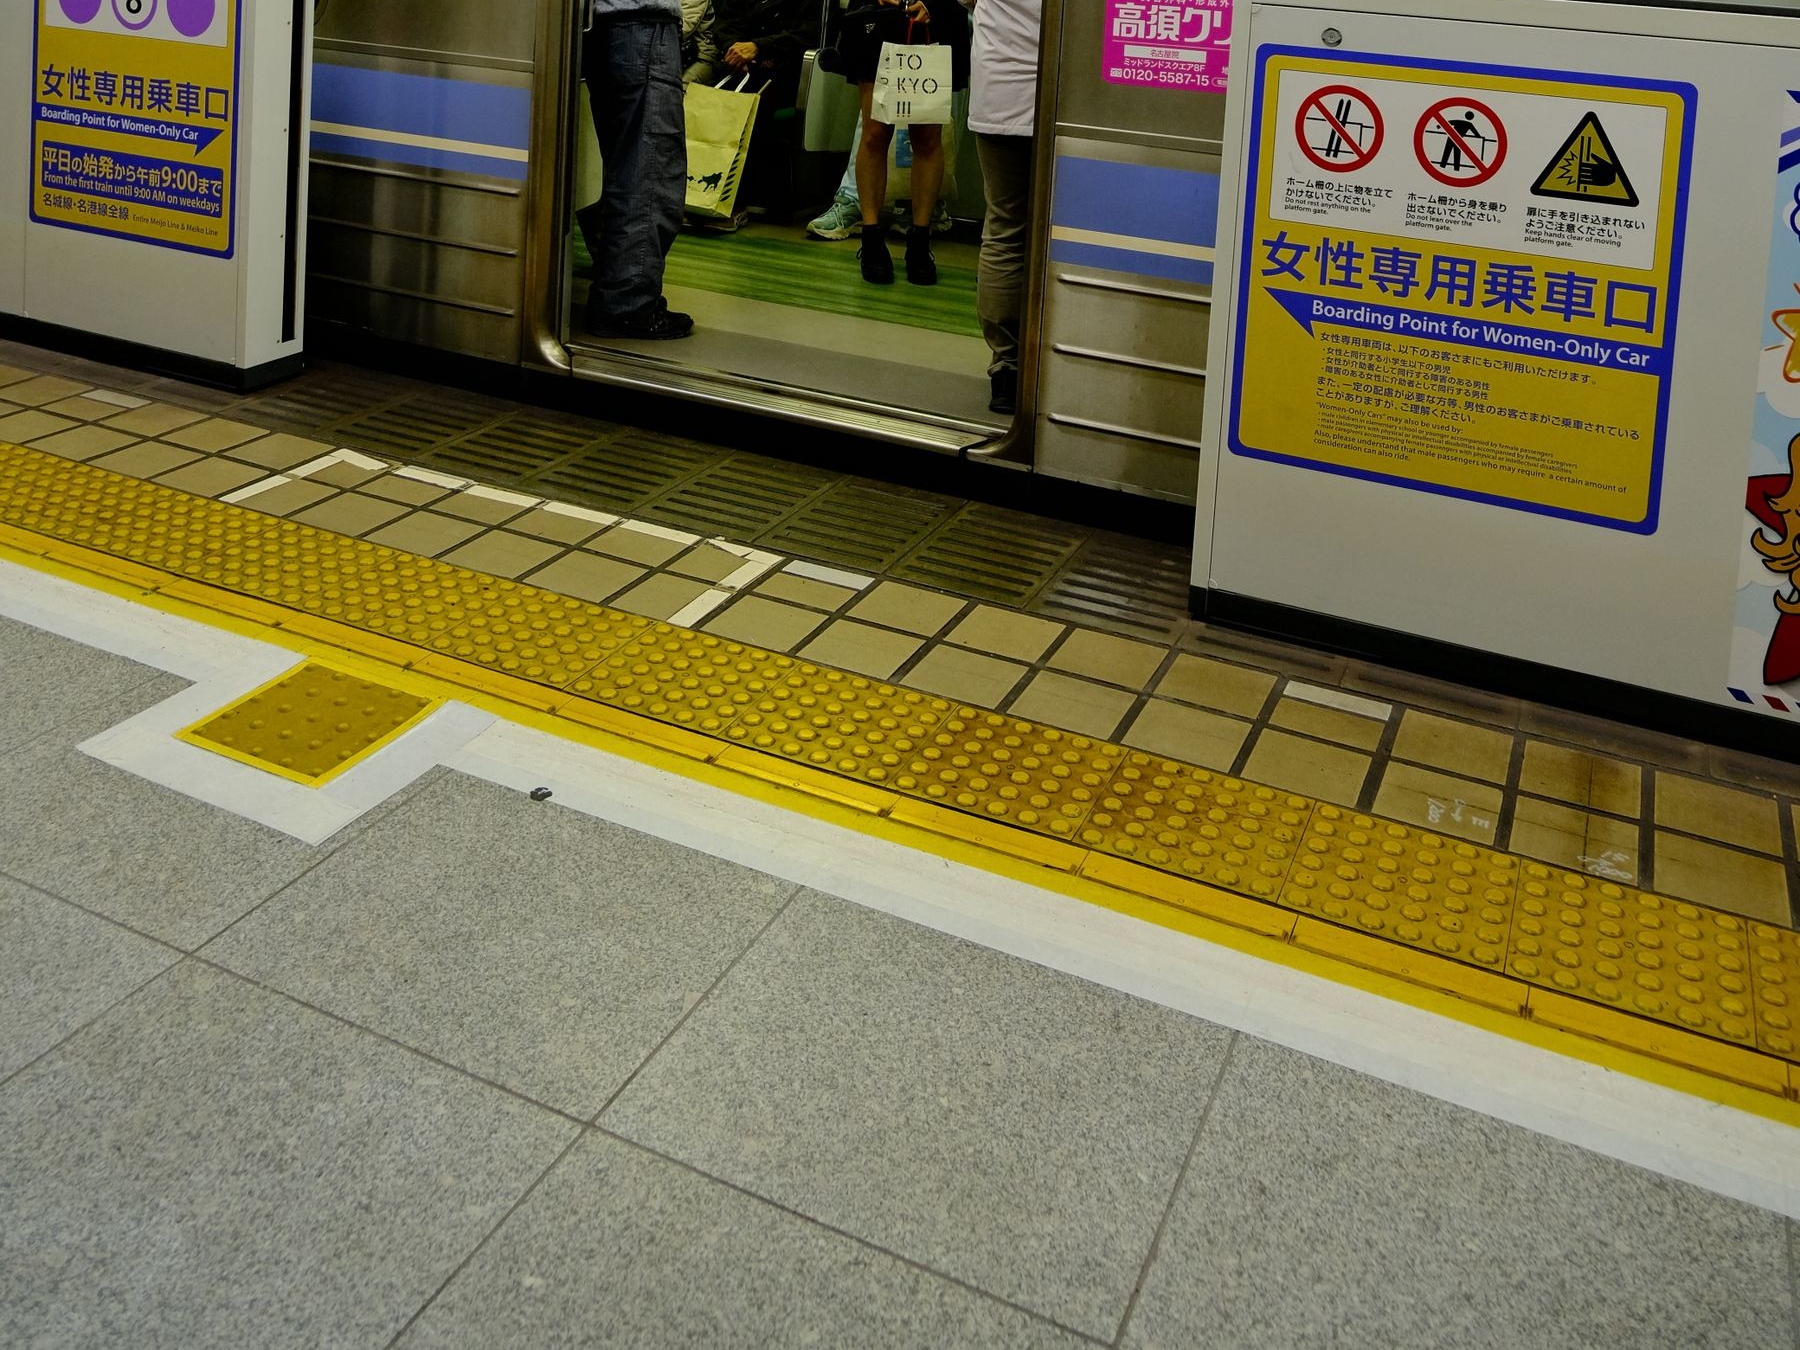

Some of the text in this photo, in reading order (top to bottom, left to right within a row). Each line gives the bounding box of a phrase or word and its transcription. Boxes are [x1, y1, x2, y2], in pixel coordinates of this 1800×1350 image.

[896, 54, 922, 70] TO
[1150, 49, 1179, 59] 名古屋院
[1124, 57, 1206, 72] ミッドランドスクエア8F
[897, 77, 937, 94] KYO
[1123, 68, 1209, 86] 0120-5587-15
[42, 64, 229, 121] 女性専用乗車口
[41, 107, 199, 140] Boarding Point for Women-Only Car
[43, 146, 222, 197] 平日の始発から午前9:00まで
[44, 171, 220, 213] From the first train until 9:00 AM on weekdays
[1286, 177, 1393, 198] ホーム柵の上に物を立て
[1286, 188, 1376, 207] かけないでください。
[43, 193, 129, 220] 名城線・名港線全線
[1285, 204, 1311, 212] platform
[1321, 203, 1349, 211] anything
[1408, 192, 1507, 212] ホーム柵から身を乗り
[1406, 203, 1501, 223] 出さないでください。
[1430, 215, 1443, 223] lean
[1526, 206, 1645, 229] 扉に手を引き込まれない
[133, 214, 149, 224] Entire
[150, 217, 166, 228] Meijo
[167, 221, 180, 230] Line
[186, 225, 204, 234] Meiko
[206, 228, 218, 236] Line
[1405, 220, 1433, 229] platform
[1526, 219, 1622, 240] ようご注意ください。
[1524, 236, 1554, 245] platform
[1525, 229, 1542, 237] Keep
[1544, 231, 1565, 239] hands
[1567, 233, 1584, 241] clear
[1594, 238, 1621, 247] moving
[1261, 231, 1658, 334] 女性専用乗車口
[1312, 300, 1650, 367] Boarding Point for Women-Only Car
[1321, 332, 1597, 386] 女性専用車両は、以下のお客さまにもご利用いただけます。
[1316, 388, 1476, 424] ことがありますが、ご理解ください。
[1387, 415, 1402, 424] may
[1404, 418, 1419, 426] also
[1452, 426, 1463, 434] by:
[1313, 438, 1363, 452] consideration
[1378, 450, 1393, 458] also
[1314, 430, 1331, 439] Also,
[1333, 433, 1356, 442] please
[1358, 439, 1399, 450] understand
[1401, 446, 1416, 454] that
[1417, 449, 1436, 457] male
[1437, 453, 1479, 466] passengers
[1481, 461, 1498, 469] who
[1500, 464, 1516, 473] may
[1518, 469, 1546, 478] require
[1555, 475, 1583, 485] certain
[1584, 480, 1616, 491] amount
